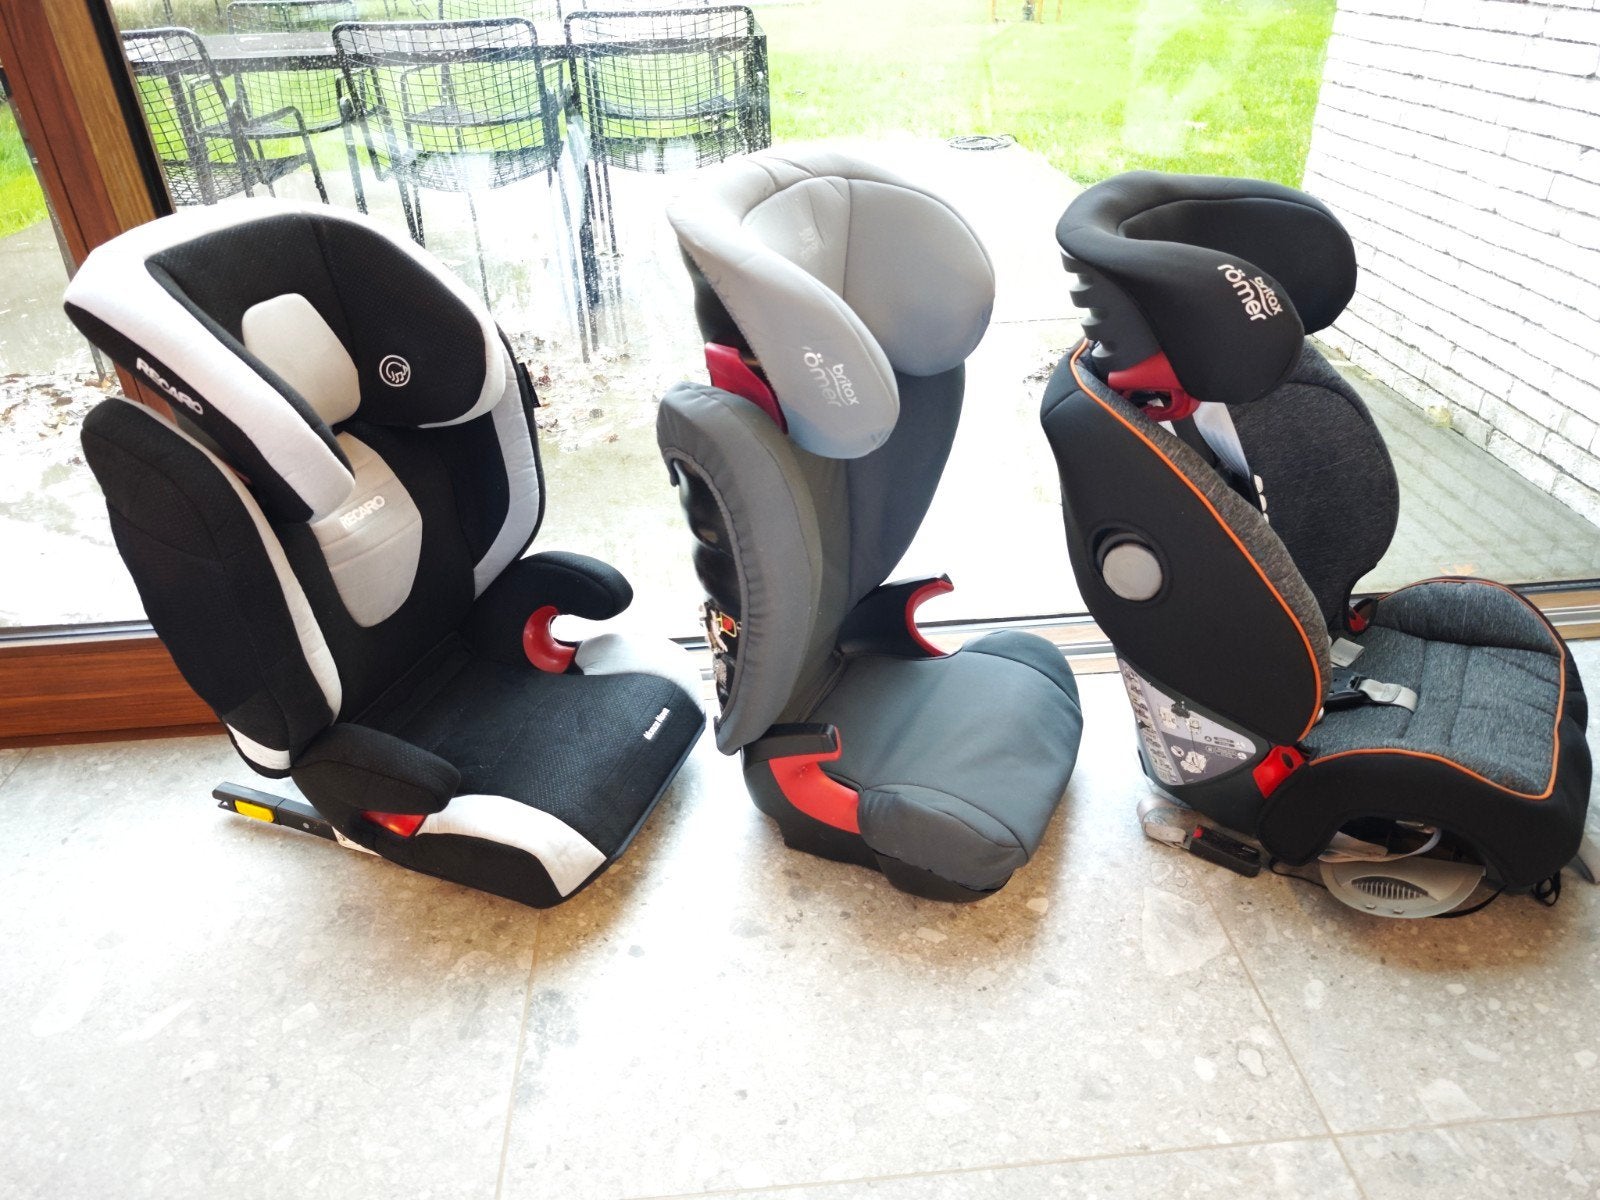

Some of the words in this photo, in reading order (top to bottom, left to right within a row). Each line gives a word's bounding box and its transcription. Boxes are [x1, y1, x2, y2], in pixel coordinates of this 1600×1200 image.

[1217, 264, 1267, 321] römer
[1254, 276, 1283, 315] britax
[136, 357, 203, 415] RECARO
[832, 363, 860, 405] britax
[339, 495, 385, 529] RECARO
